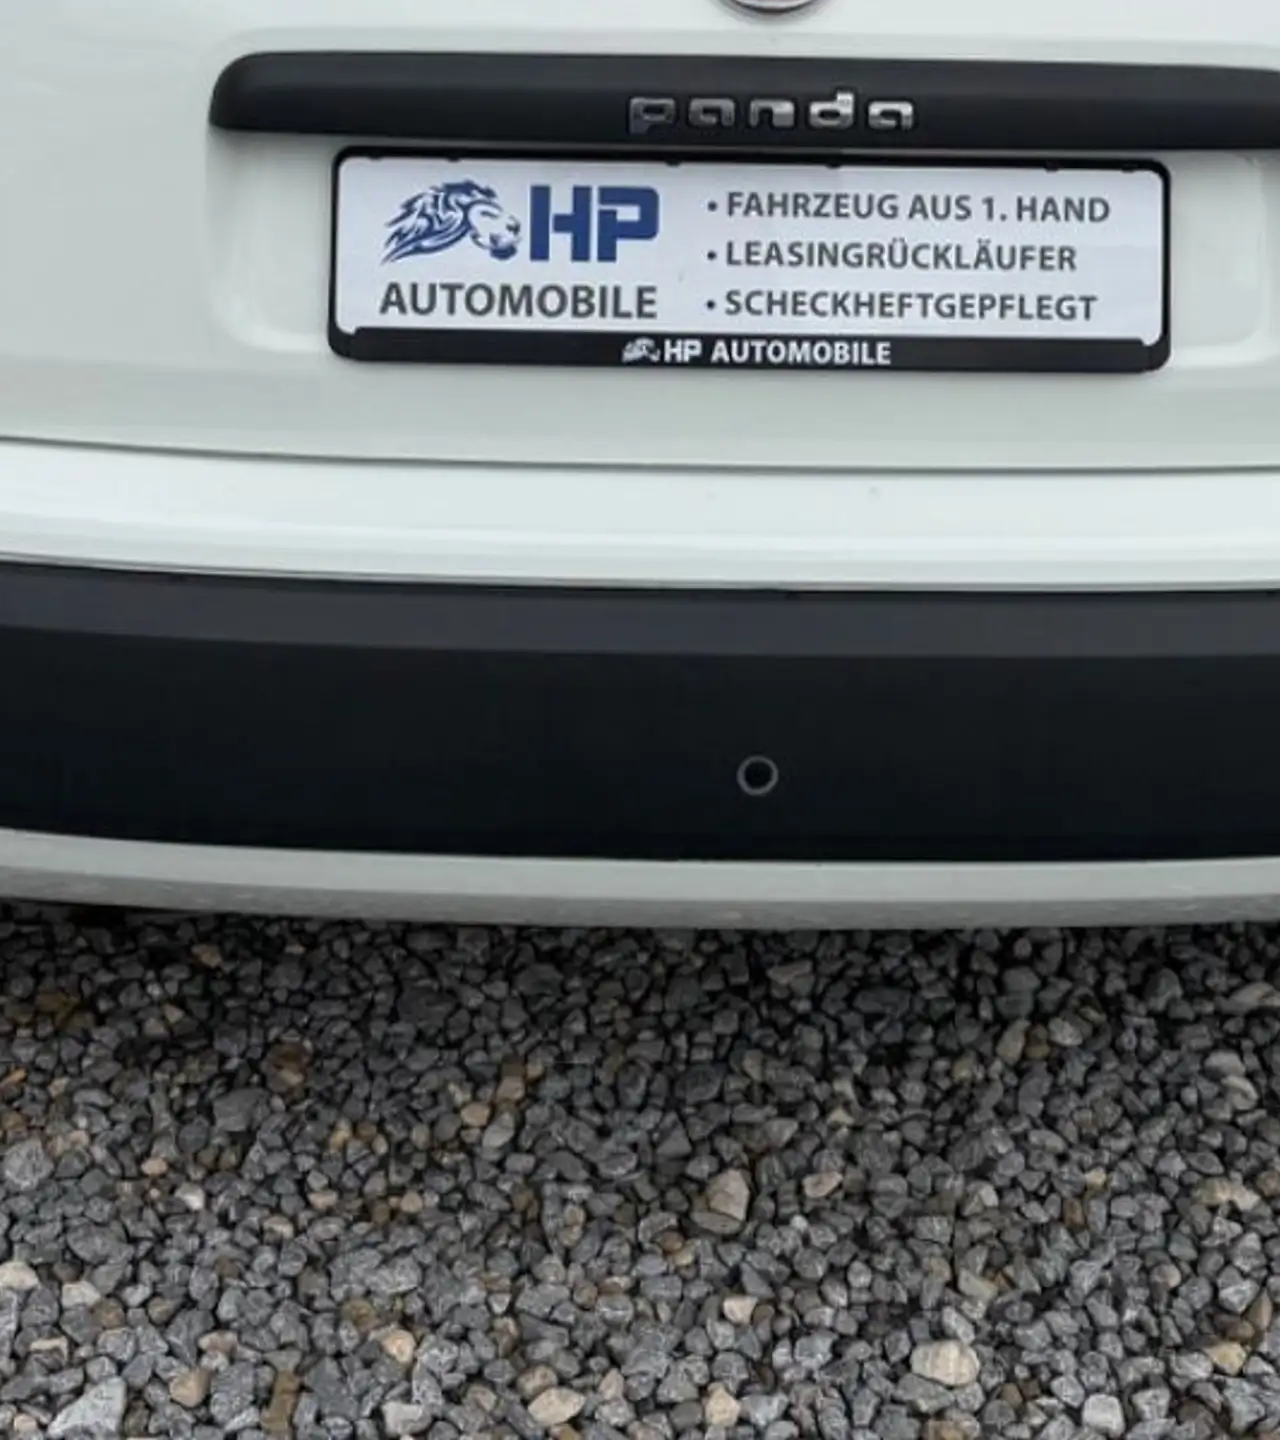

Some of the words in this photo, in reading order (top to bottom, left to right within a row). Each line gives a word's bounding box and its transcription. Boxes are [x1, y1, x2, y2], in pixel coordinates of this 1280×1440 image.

[628, 91, 914, 136] panda
[529, 184, 661, 263] HP
[726, 191, 900, 220] FAHRZEUG
[907, 194, 972, 222] AUS
[981, 196, 1008, 222] 1.
[1016, 196, 1111, 224] HAND
[726, 237, 1078, 272] LEASINGRÜCKLÄUFER
[378, 281, 658, 320] AUTOMOBILE
[724, 289, 1099, 322] SCHECKHEFTGEPFLEGT
[663, 338, 703, 363] HP
[710, 339, 892, 367] AUTOMOBILE
